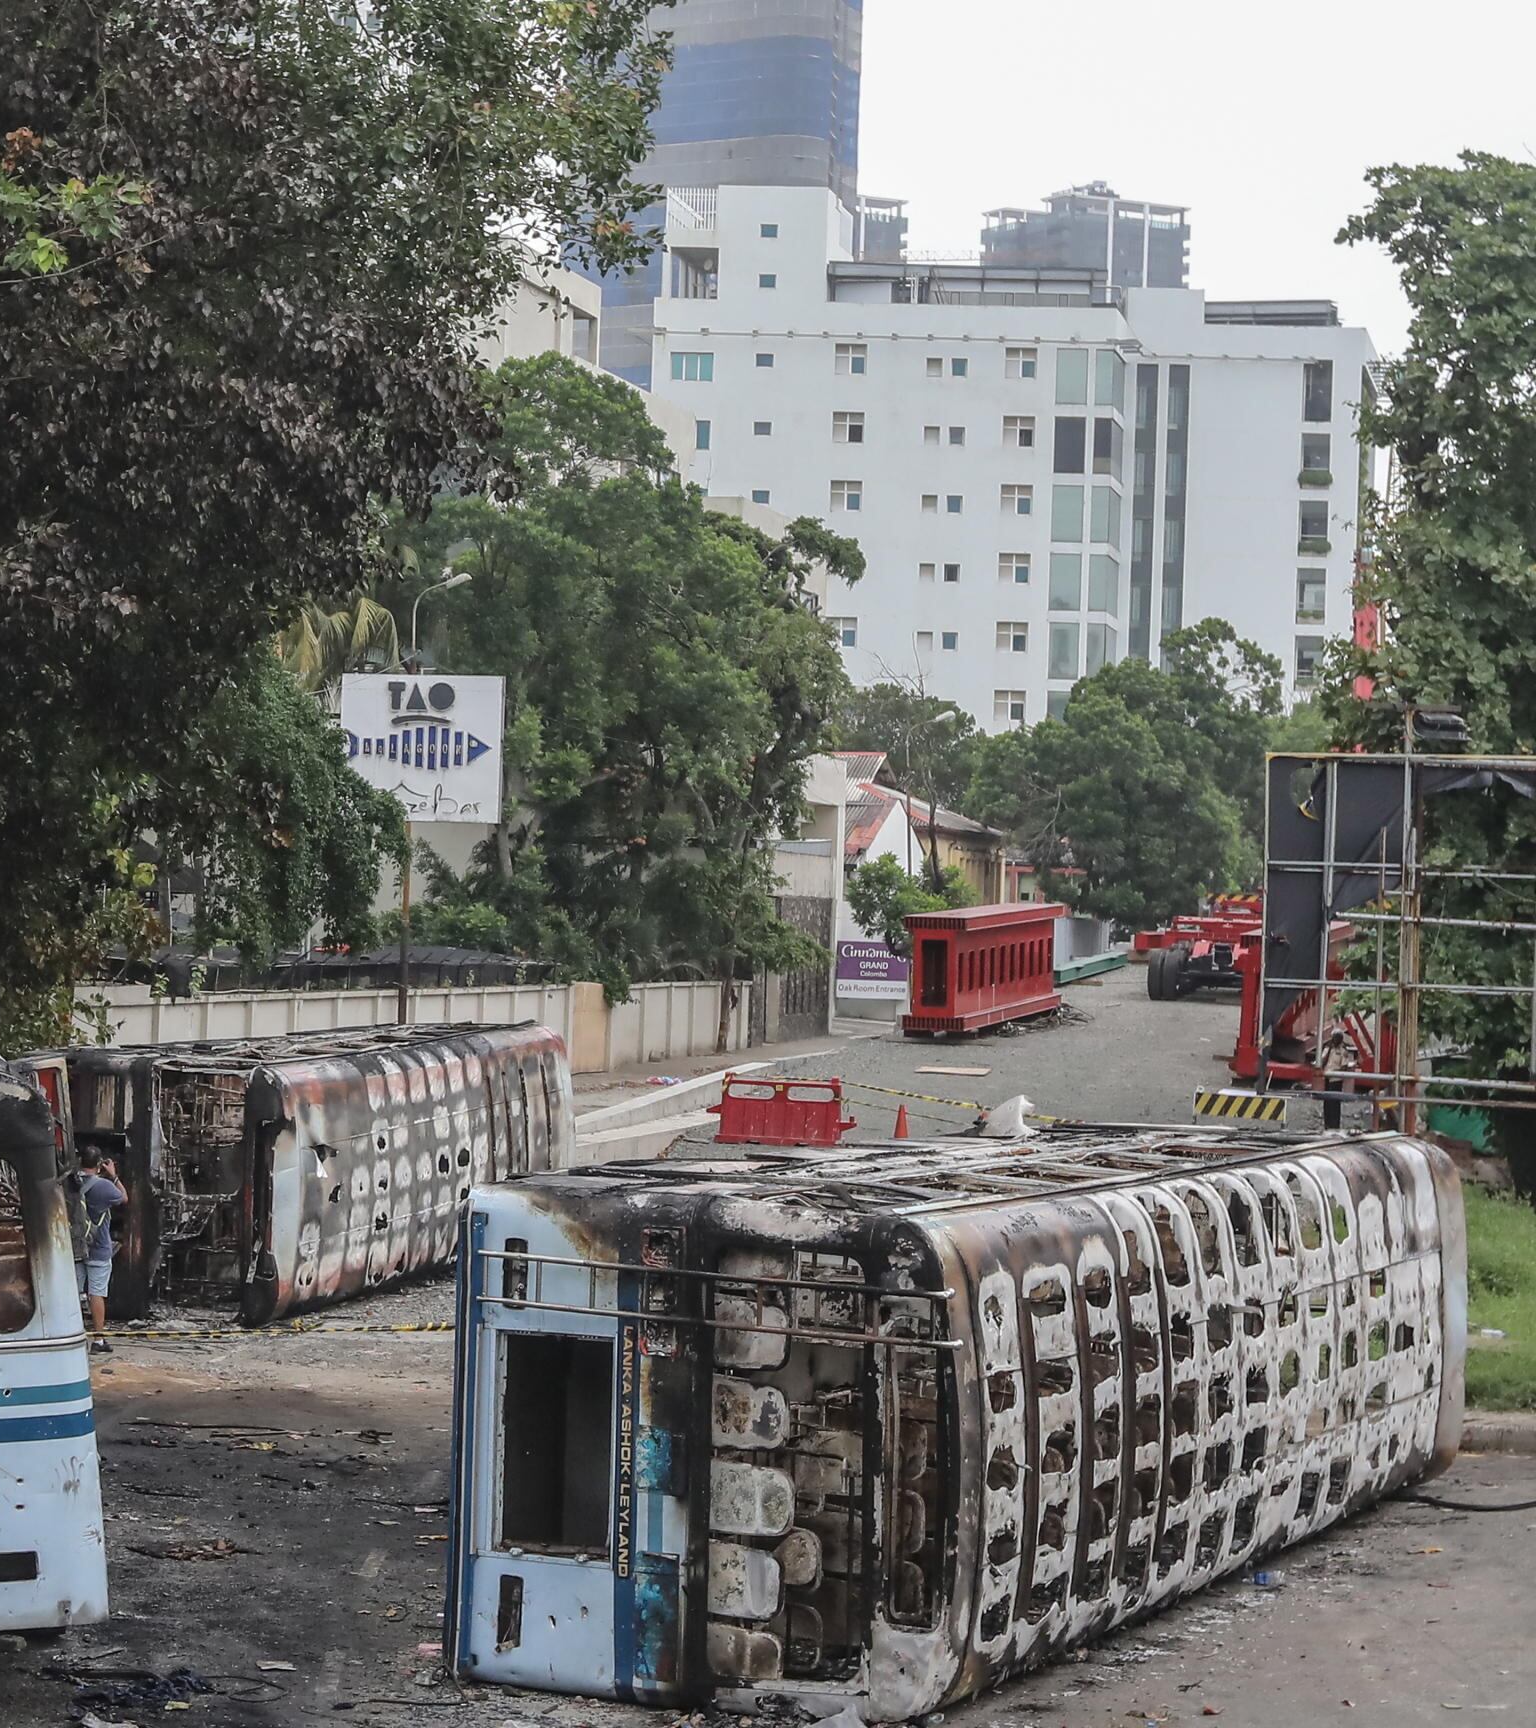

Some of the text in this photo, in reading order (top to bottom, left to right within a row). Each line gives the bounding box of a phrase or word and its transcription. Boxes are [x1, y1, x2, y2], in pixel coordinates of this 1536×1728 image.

[388, 681, 455, 711] TAO
[433, 783, 480, 815] Bar
[859, 962, 888, 970] GRAND
[838, 984, 905, 993] Oak Room Entrance
[618, 1326, 633, 1578] LANKA ASHOK LEYLAND
